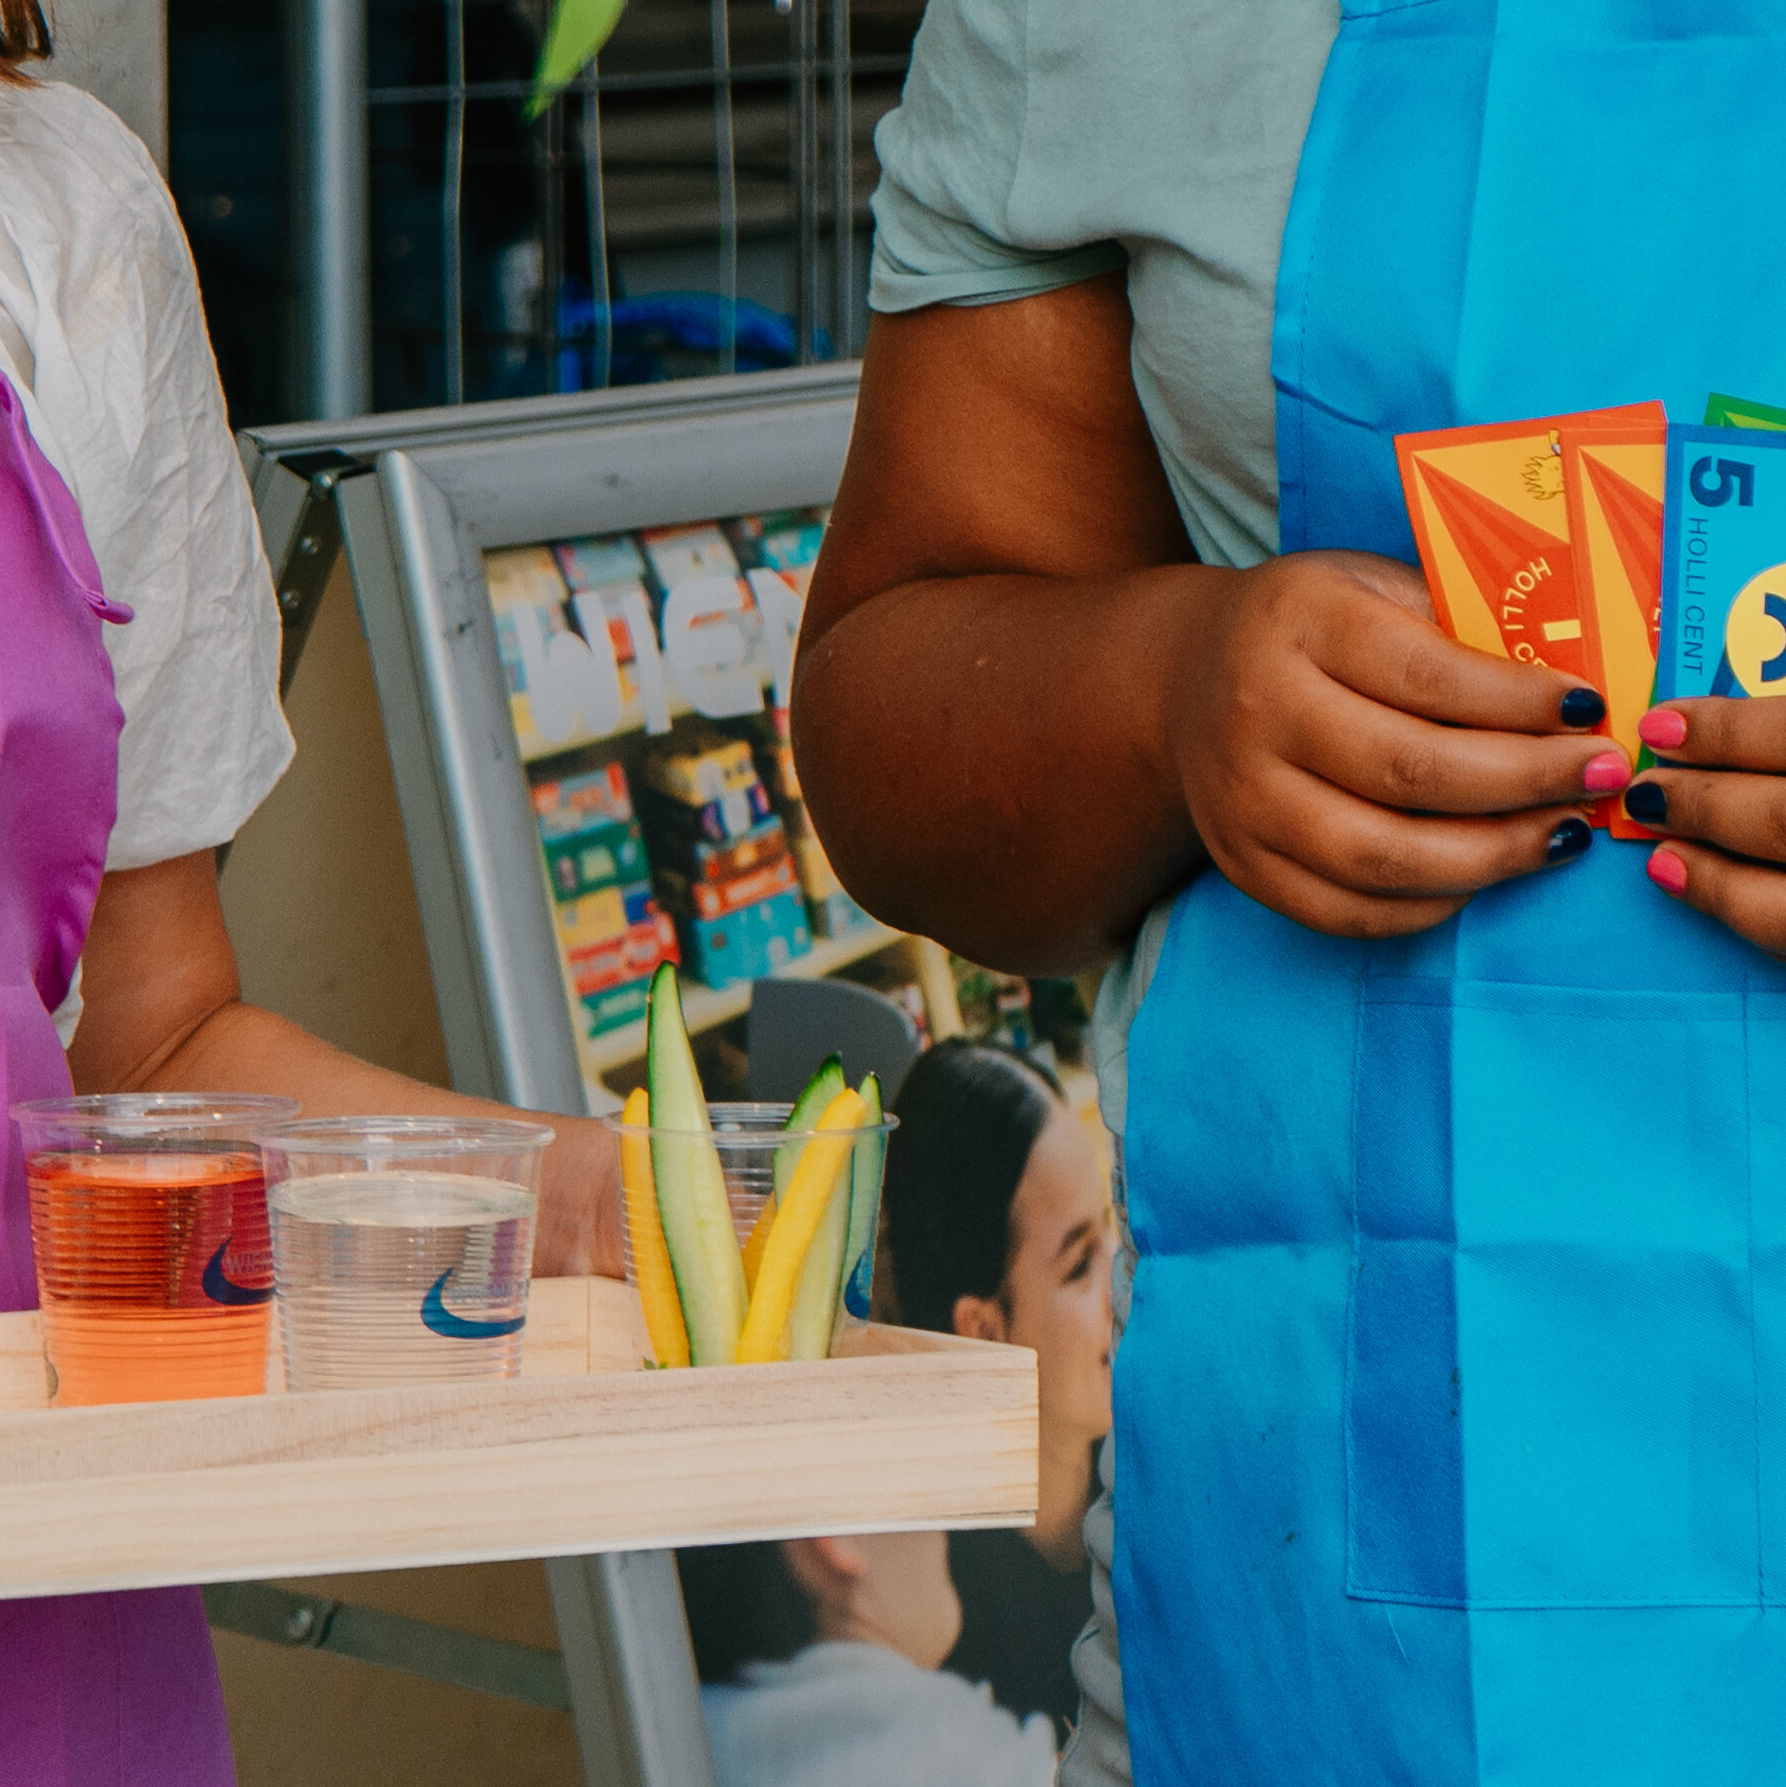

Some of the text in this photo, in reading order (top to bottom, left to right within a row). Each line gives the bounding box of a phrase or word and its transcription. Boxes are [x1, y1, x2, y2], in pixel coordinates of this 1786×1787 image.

[1690, 455, 1755, 507] 5
[1503, 556, 1553, 631] HOLLI
[1682, 516, 1709, 676] HOLLI CENT
